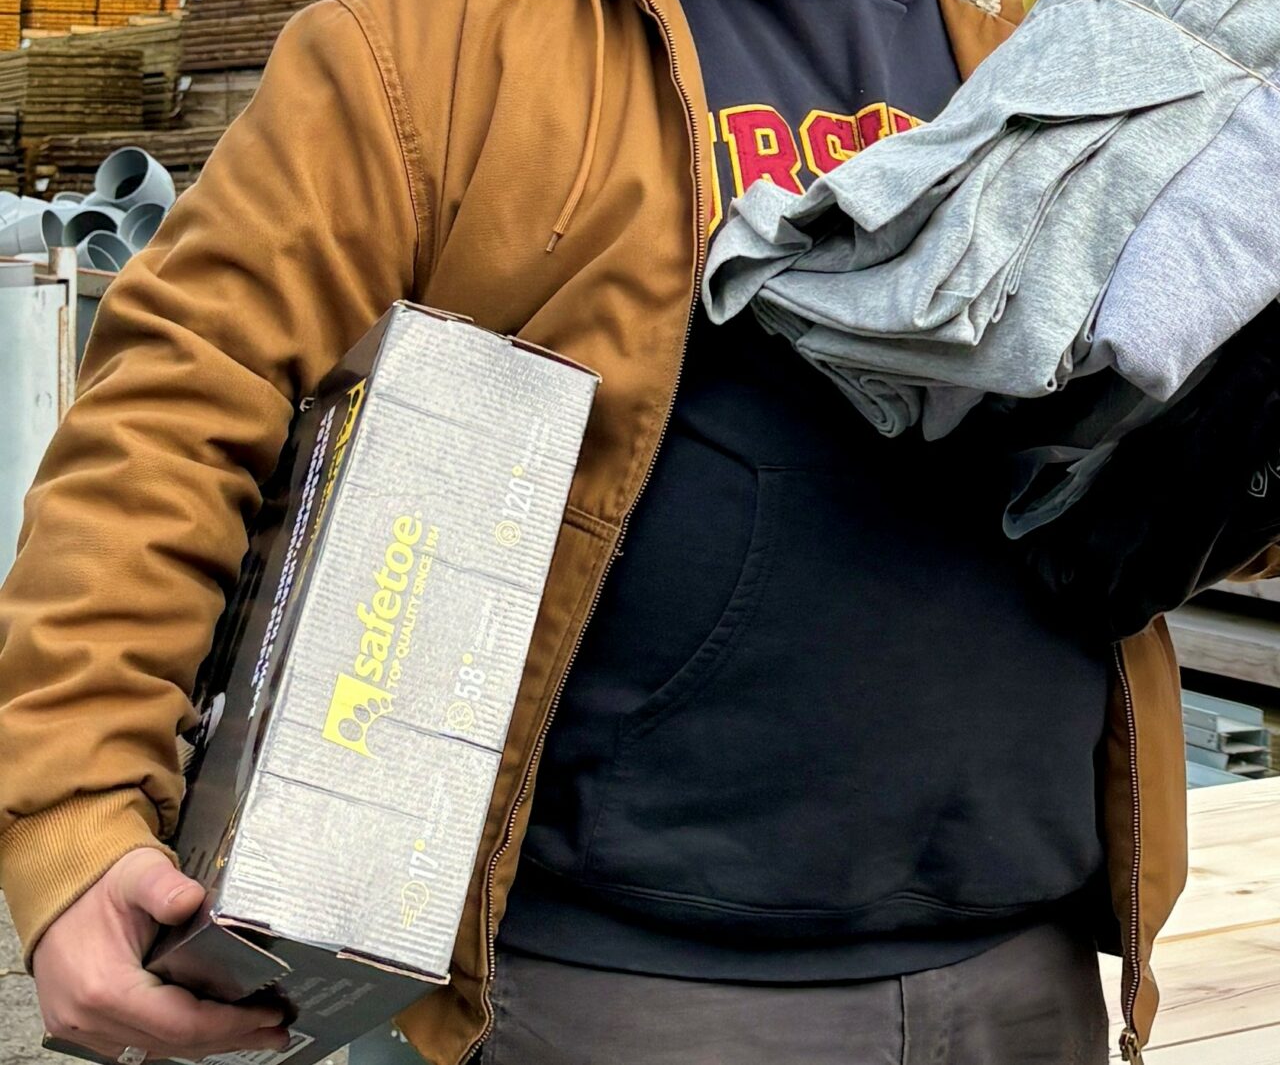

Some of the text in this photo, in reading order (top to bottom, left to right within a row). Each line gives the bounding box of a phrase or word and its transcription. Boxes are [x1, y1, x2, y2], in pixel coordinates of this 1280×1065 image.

[354, 515, 422, 683] safetoe
[385, 524, 441, 689] TOP QUALITY SINCE 1984
